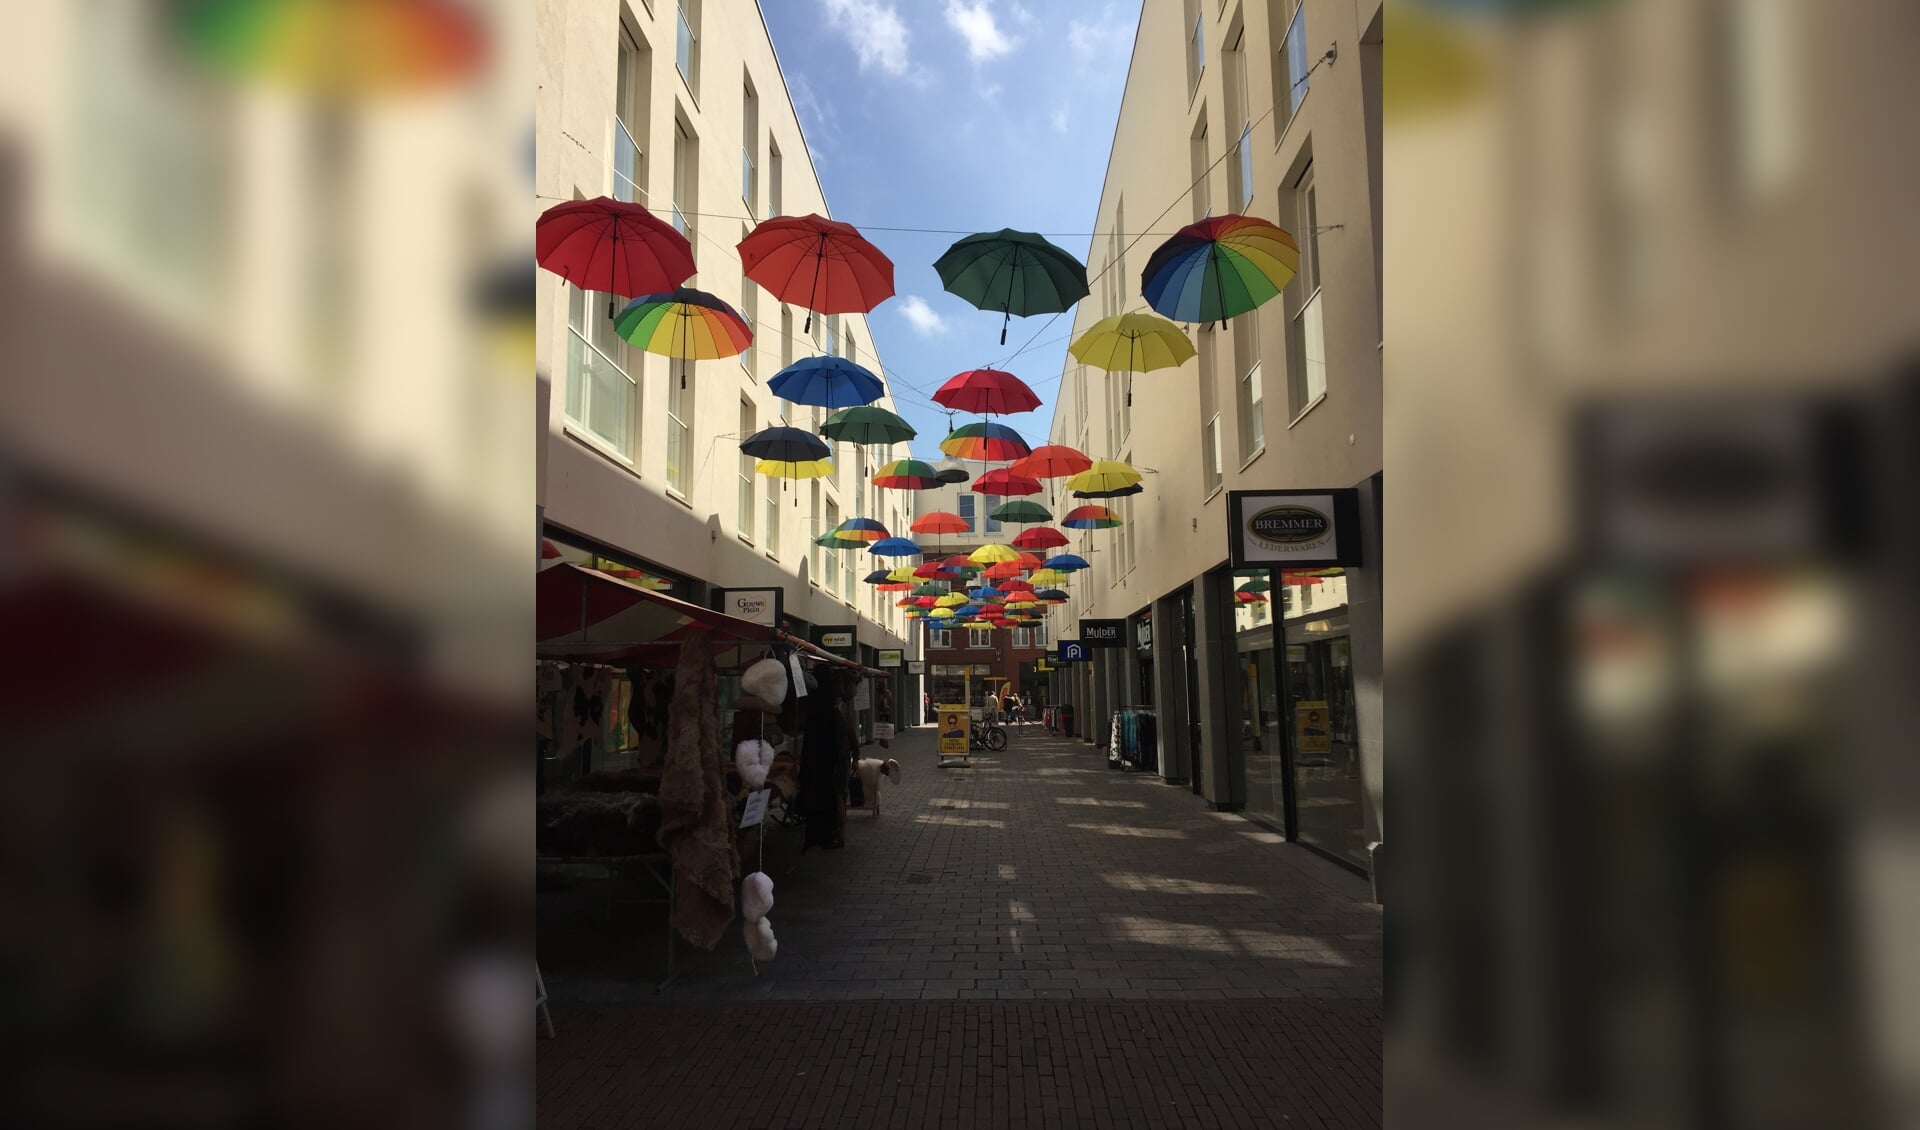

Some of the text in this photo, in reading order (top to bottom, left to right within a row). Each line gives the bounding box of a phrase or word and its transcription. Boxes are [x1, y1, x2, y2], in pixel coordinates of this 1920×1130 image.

[1255, 519, 1323, 529] BREMMER
[1259, 540, 1325, 552] LEDERWAREN
[1070, 648, 1078, 658] P
